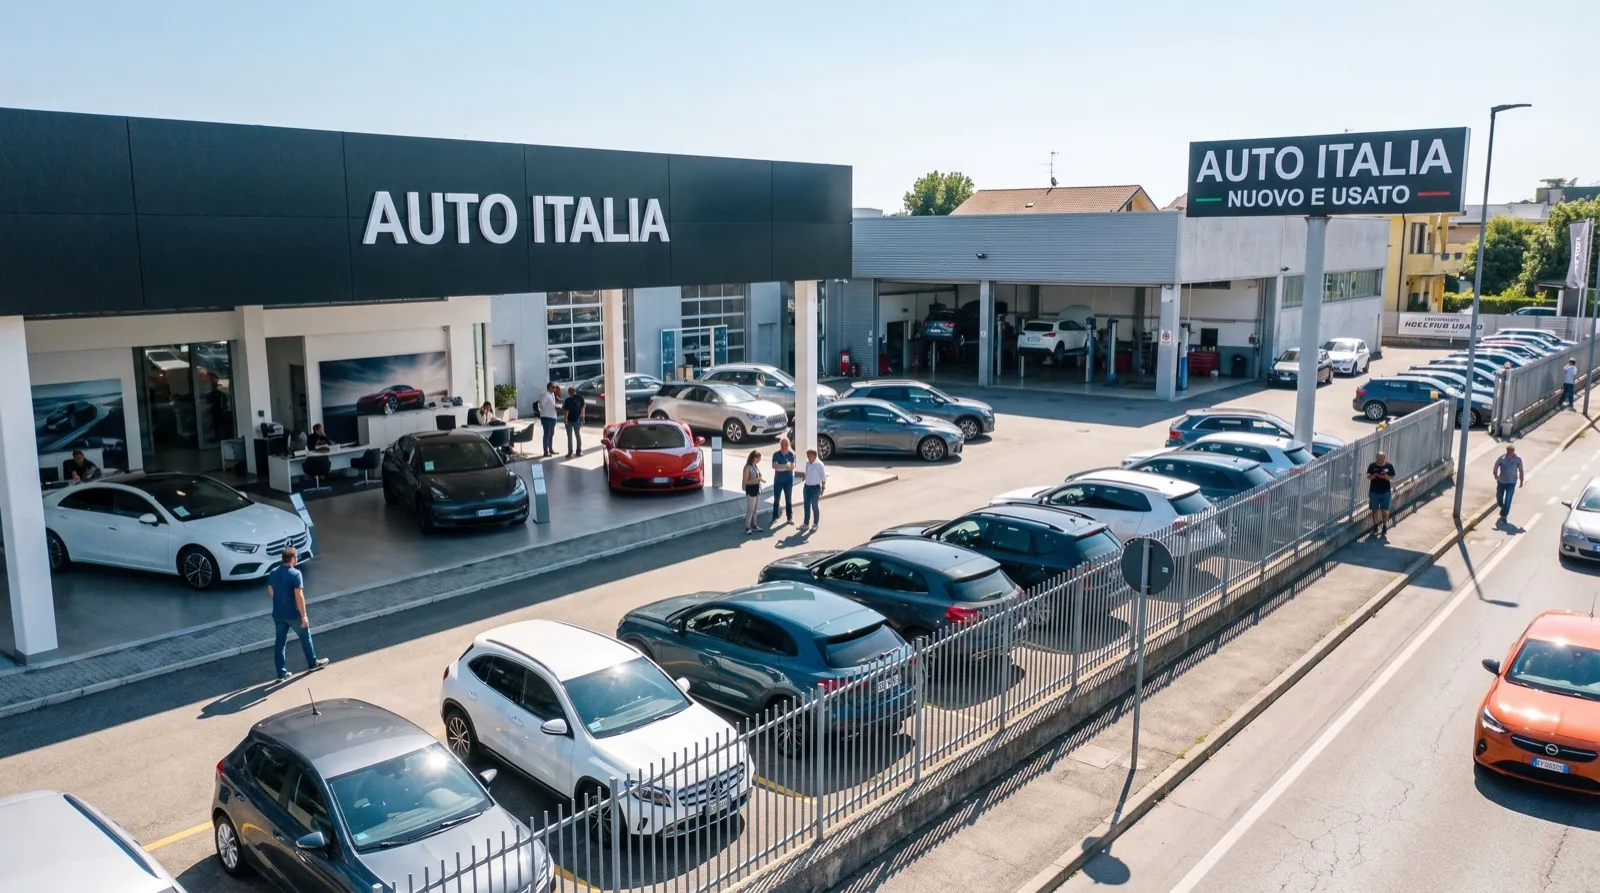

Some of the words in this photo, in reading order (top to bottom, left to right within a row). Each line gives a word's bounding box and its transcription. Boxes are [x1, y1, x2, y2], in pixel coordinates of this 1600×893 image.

[1196, 146, 1304, 182] AUTO
[1317, 138, 1453, 179] ITALIA
[1228, 188, 1305, 207] NUOVO
[1311, 187, 1325, 205] E
[1331, 185, 1410, 205] USATO
[362, 190, 519, 245] AUTO
[532, 195, 670, 243] ITALIA
[1451, 323, 1483, 331] USAO
